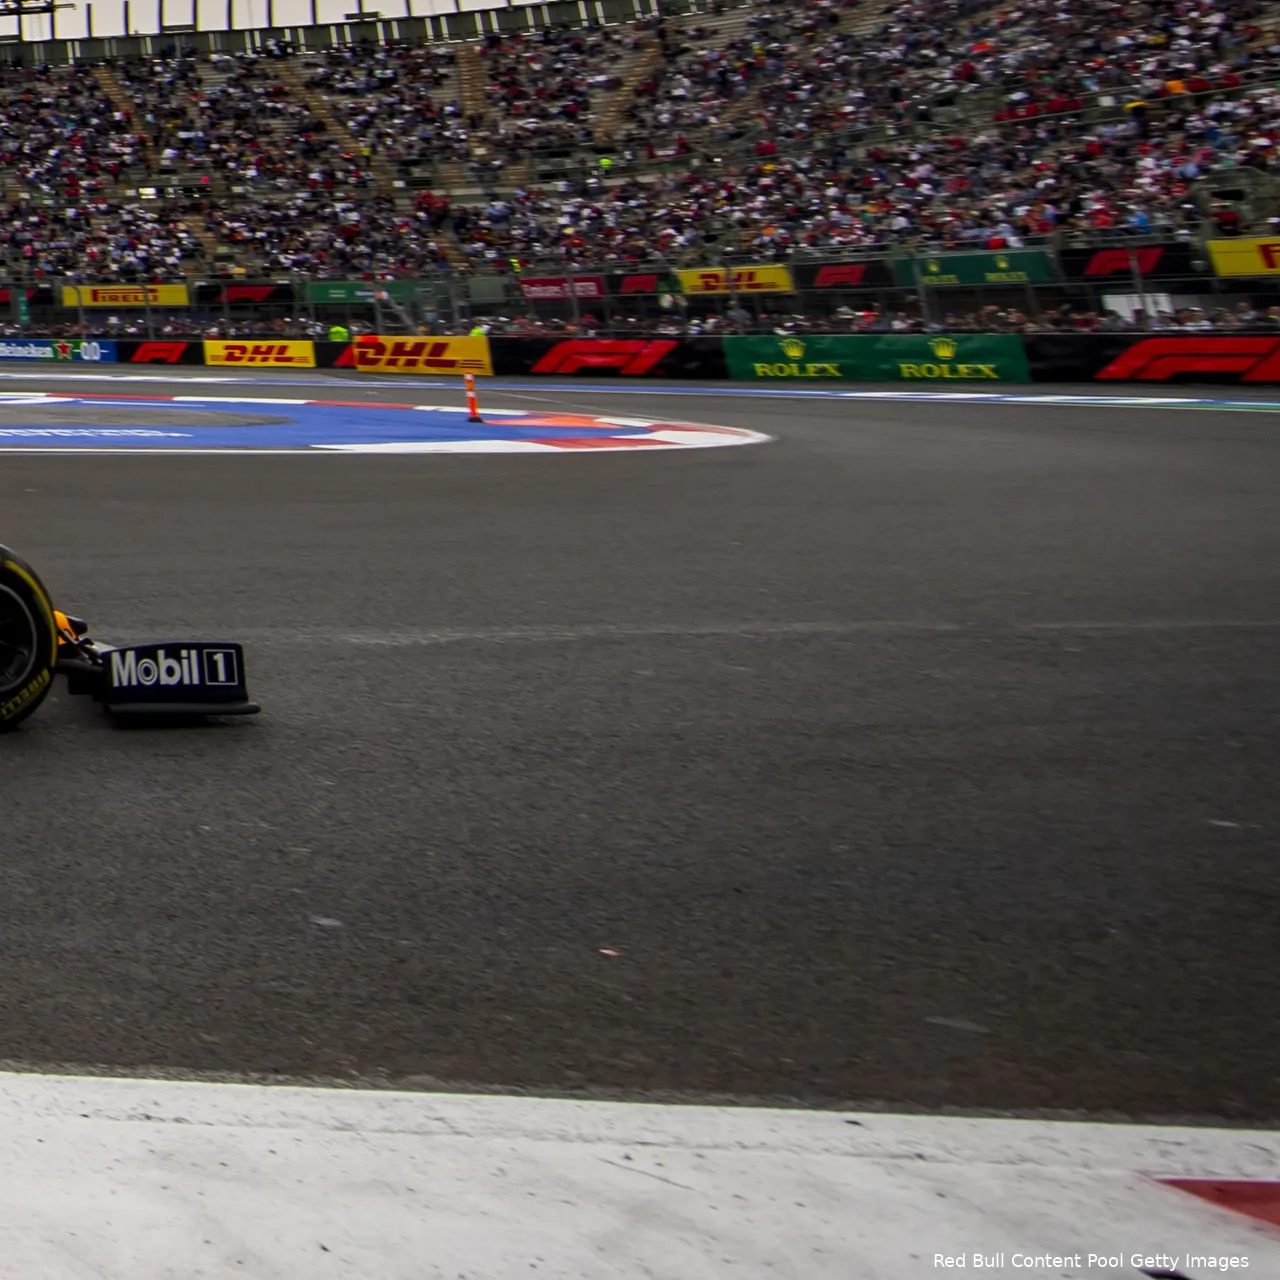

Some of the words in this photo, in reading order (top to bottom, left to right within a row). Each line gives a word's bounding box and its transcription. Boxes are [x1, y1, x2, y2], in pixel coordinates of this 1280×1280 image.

[223, 344, 294, 363] DHL
[355, 341, 458, 367] DHL
[752, 363, 843, 377] ROLEX
[897, 363, 1001, 379] ROLEX
[110, 649, 201, 688] Mobil
